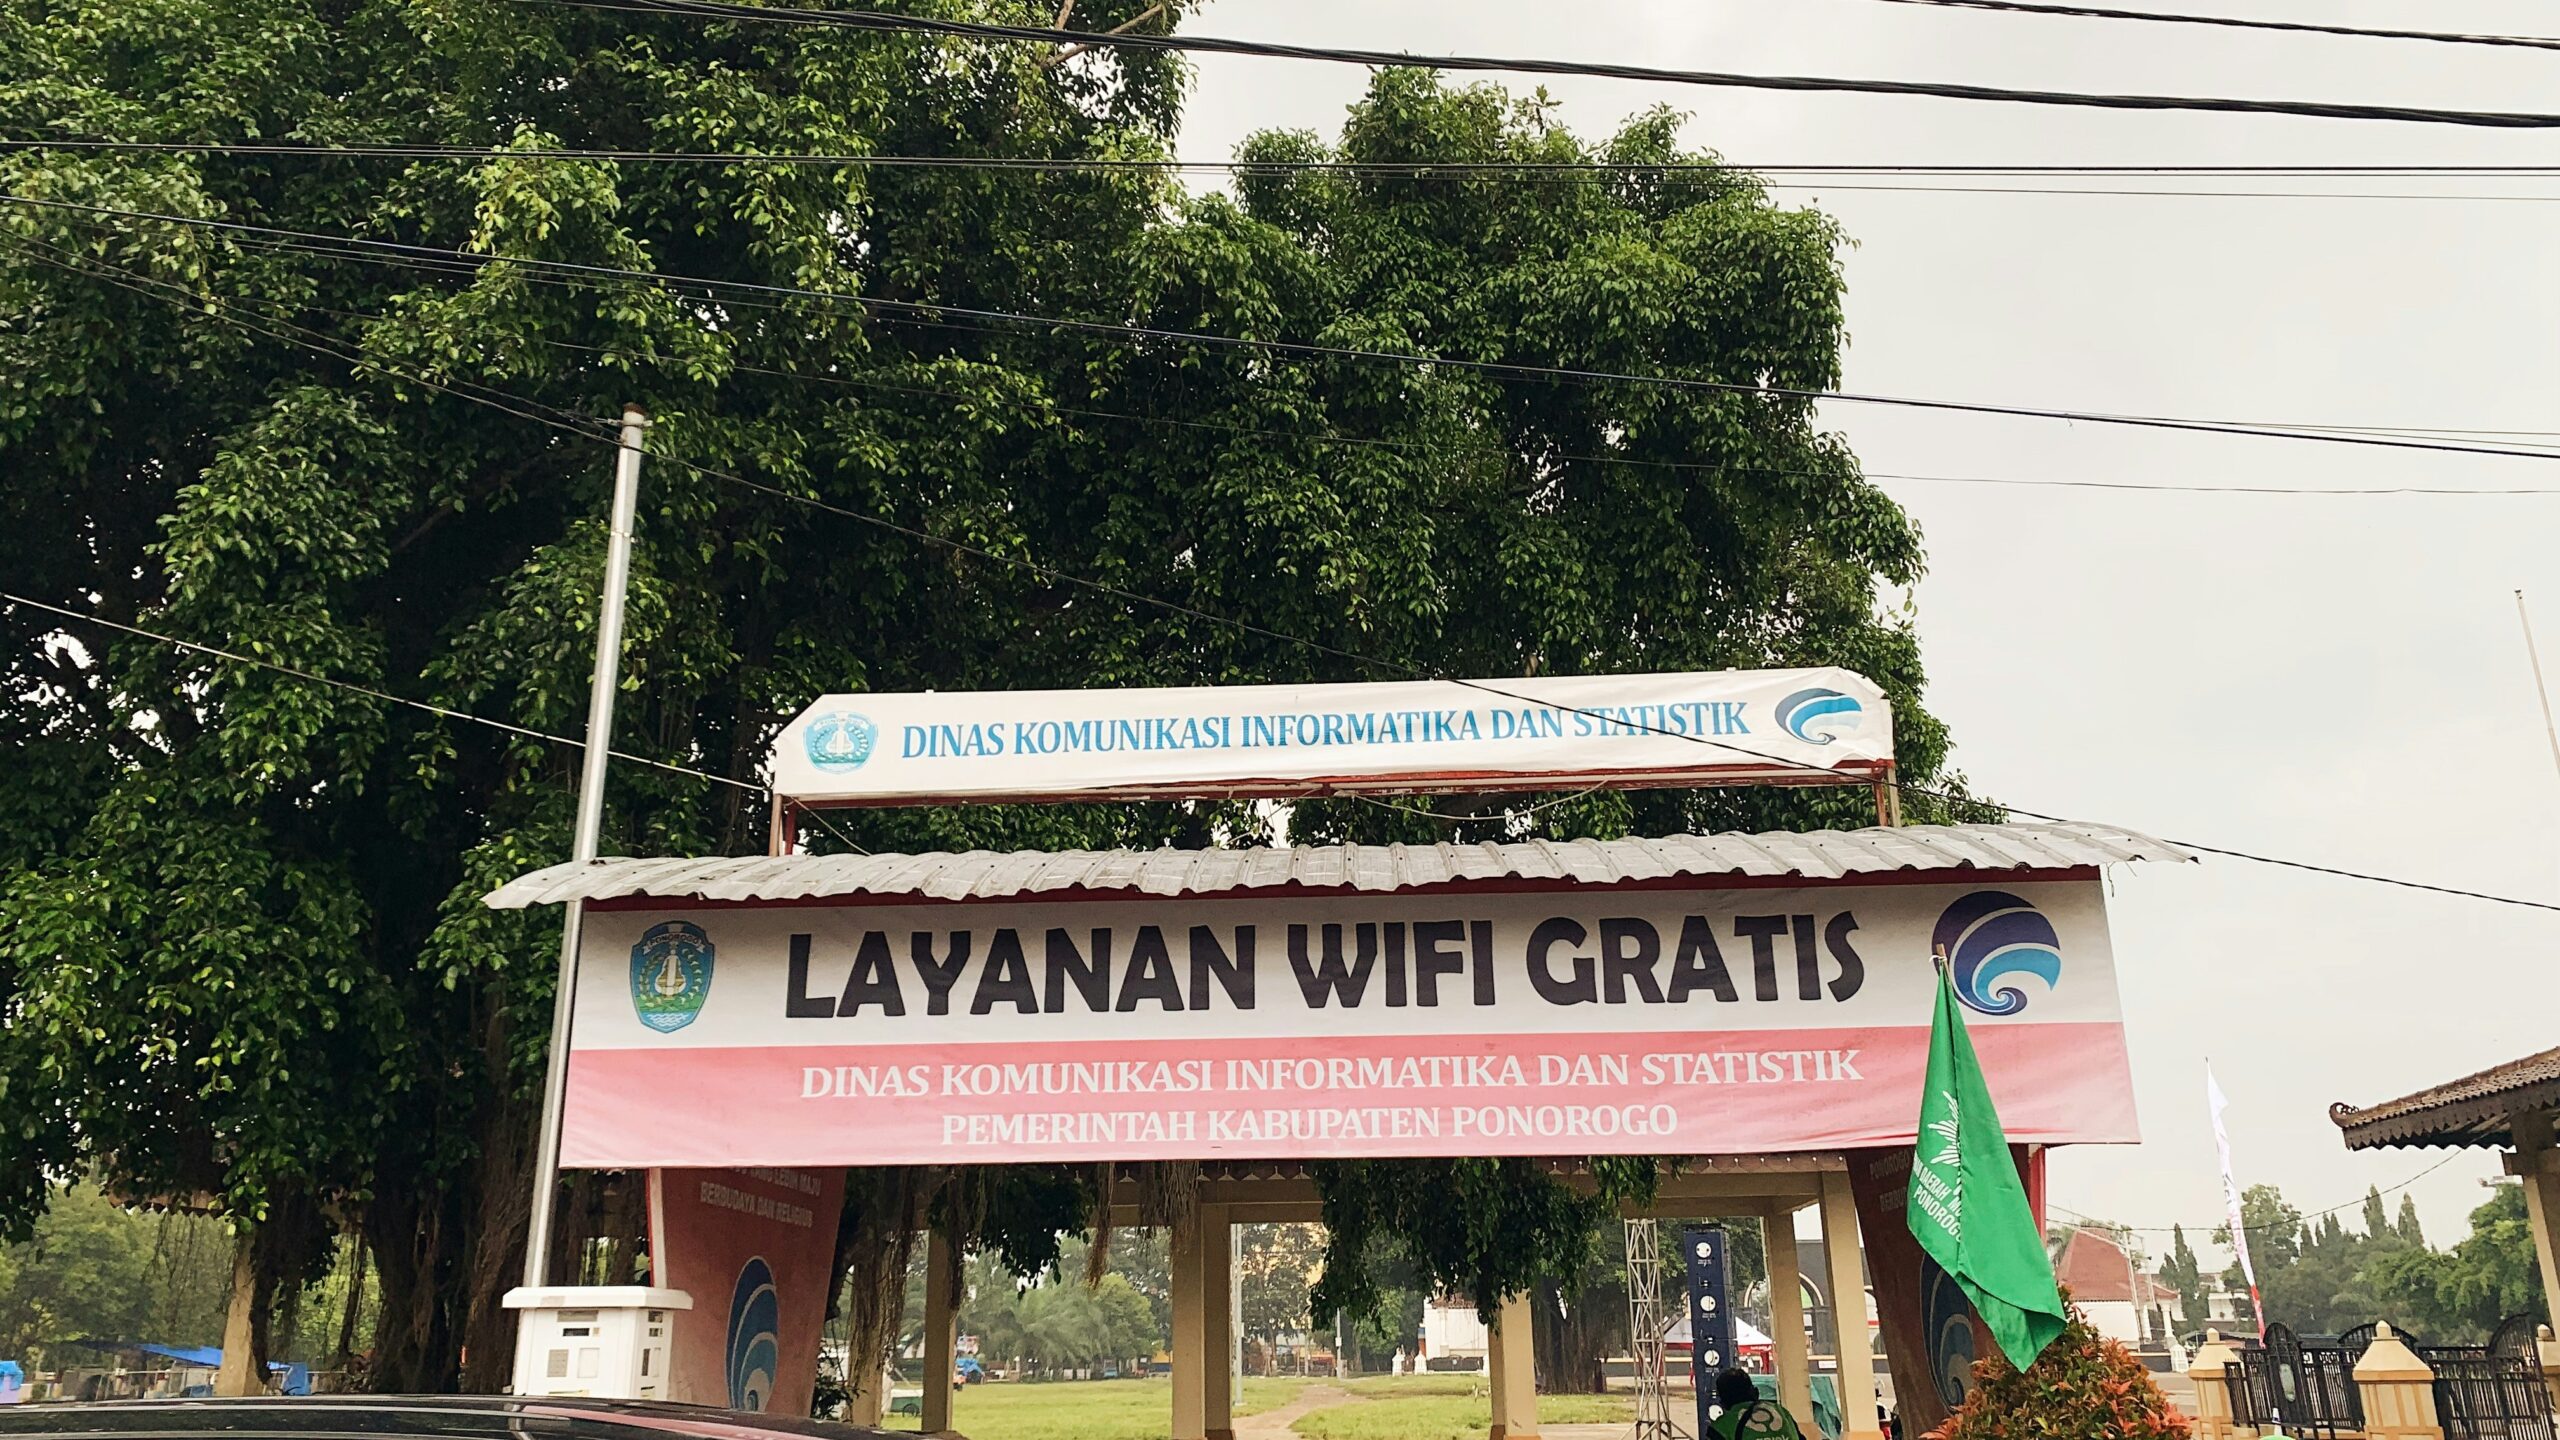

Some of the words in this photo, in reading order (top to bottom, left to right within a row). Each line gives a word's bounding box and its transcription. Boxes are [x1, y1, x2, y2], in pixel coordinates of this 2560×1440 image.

[902, 723, 1005, 759] DINAS
[1014, 716, 1231, 755] KOMUNIKASI
[1241, 708, 1482, 748] INFORMATIKA
[1491, 707, 1563, 740] DAN
[1585, 701, 1751, 738] STATISTIK
[786, 924, 1256, 1018] LAYANAN
[1287, 919, 1496, 1009] WIFI
[1526, 911, 1865, 1006] GRATIS
[801, 1065, 930, 1098] DINAS
[941, 1060, 1213, 1096] KOMUNIKASI
[1225, 1055, 1527, 1091] INFORMATIKA
[1539, 1054, 1629, 1086] DAN
[1642, 1049, 1864, 1085] STATISTIK
[940, 1110, 1197, 1146] PEMERINTAH
[1207, 1107, 1440, 1141] KABUPATEN
[1453, 1104, 1678, 1138] PONOROGO
[1919, 1166, 1952, 1201] DAERAH
